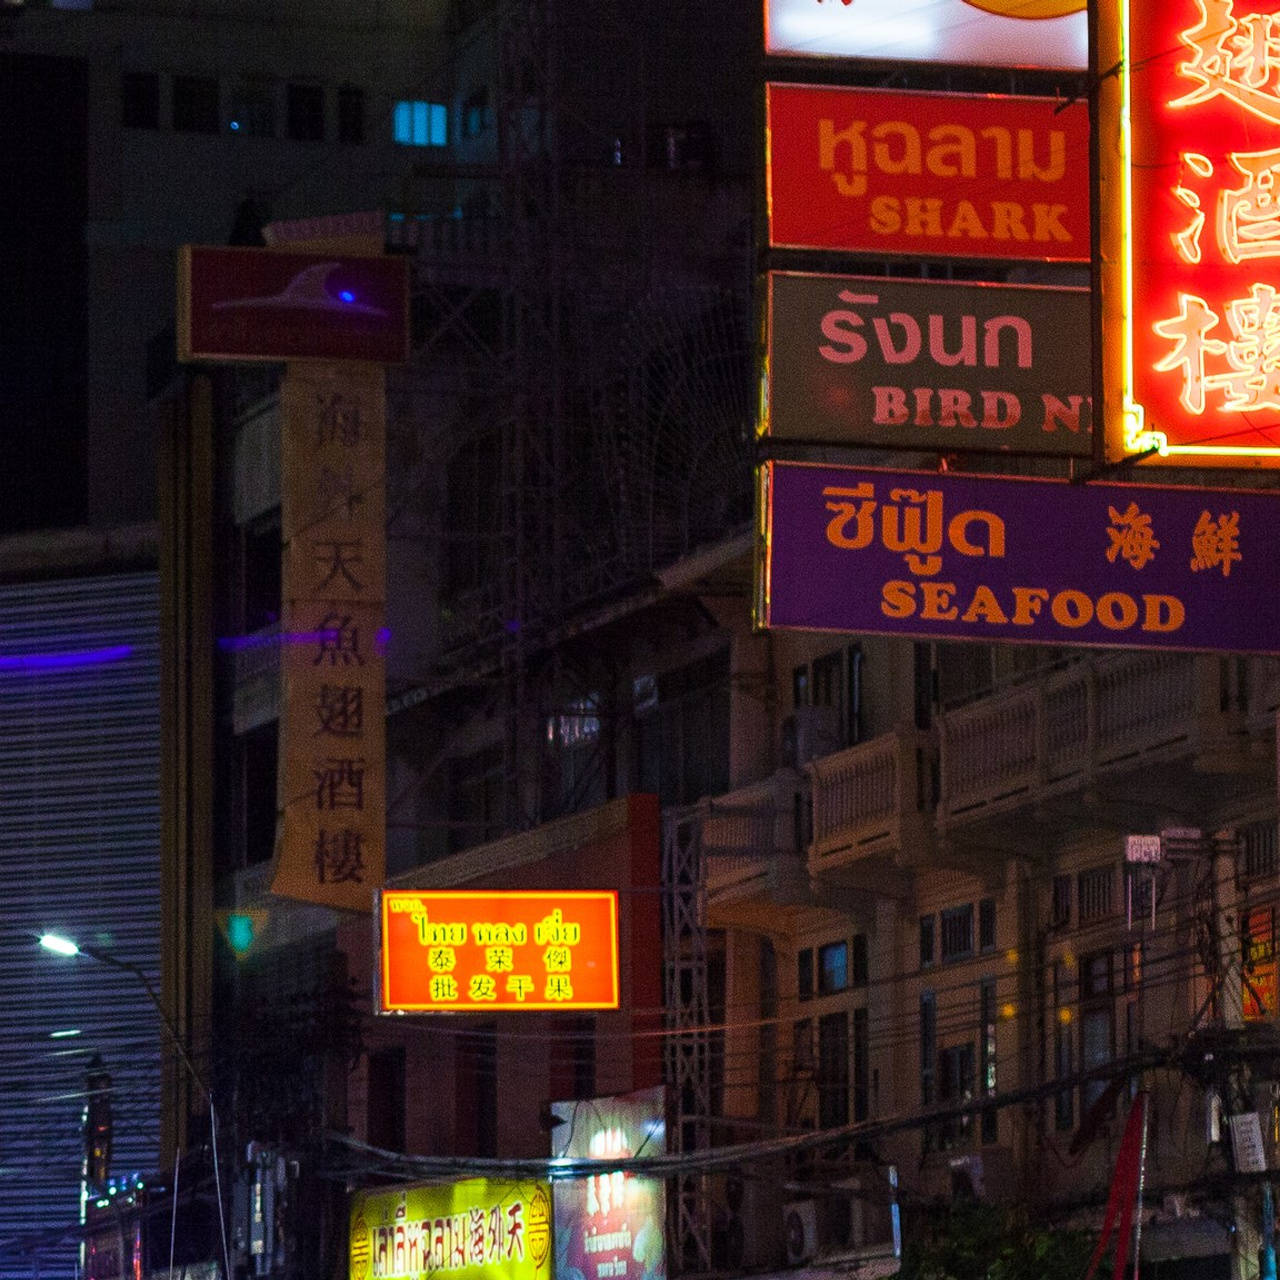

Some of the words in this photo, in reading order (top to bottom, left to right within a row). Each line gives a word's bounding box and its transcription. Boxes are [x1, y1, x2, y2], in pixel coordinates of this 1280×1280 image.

[820, 118, 1066, 197] หูฉลาม
[869, 197, 1073, 242] SHARK
[819, 290, 1034, 369] รังนก
[872, 385, 1022, 430] BIRD
[1042, 393, 1094, 434] N
[881, 581, 1186, 633] SEAFOOD
